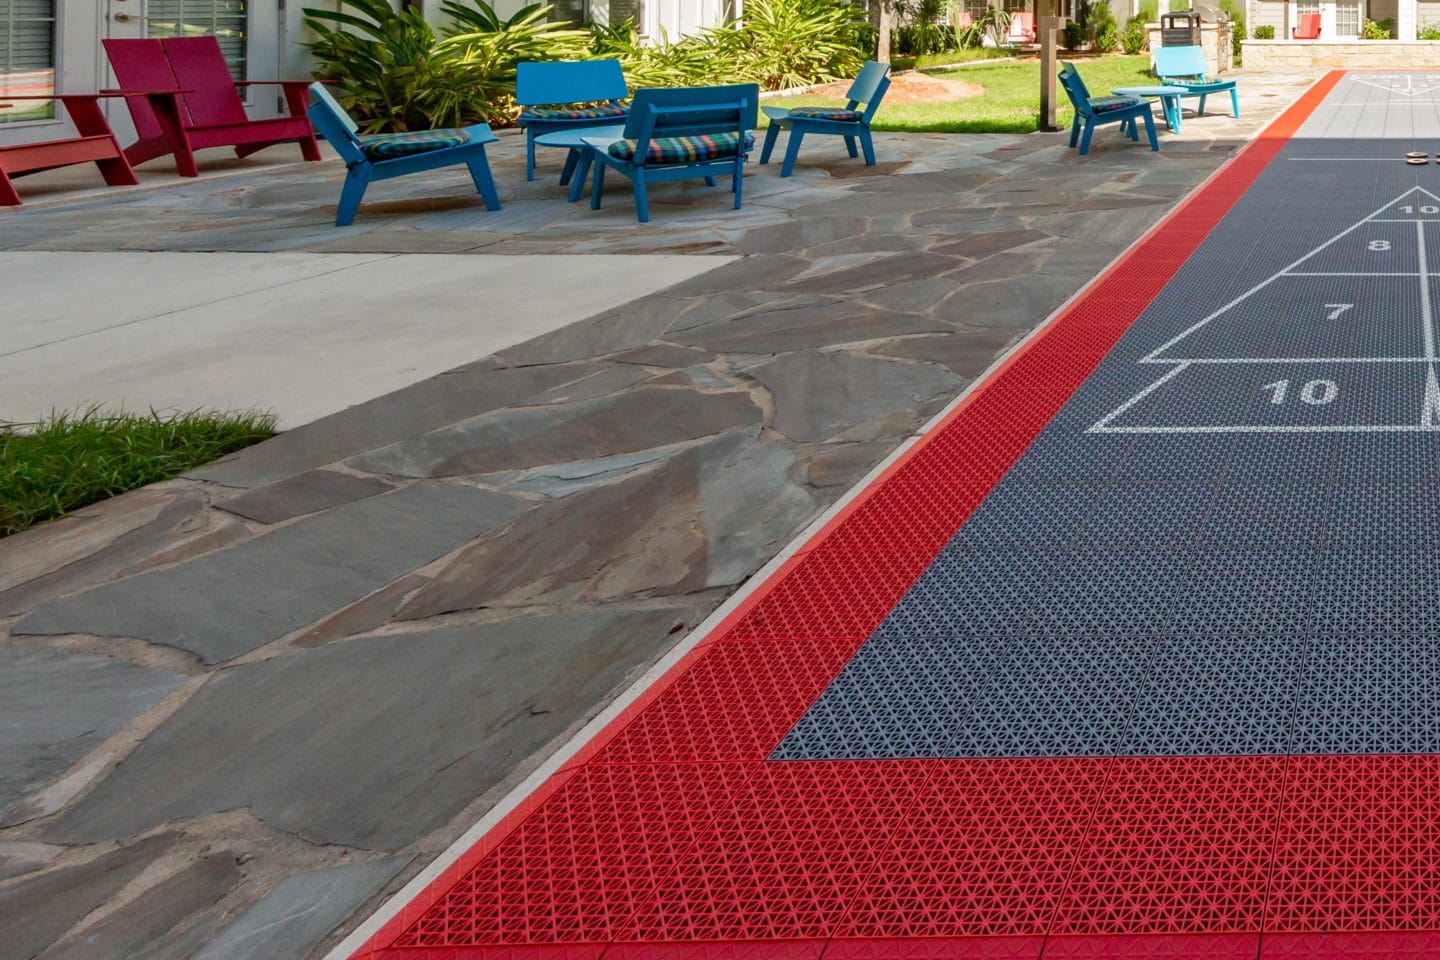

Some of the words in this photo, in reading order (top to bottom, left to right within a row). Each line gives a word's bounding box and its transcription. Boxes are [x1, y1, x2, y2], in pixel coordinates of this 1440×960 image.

[1398, 205, 1440, 214] 10
[1368, 240, 1392, 251] 8
[1324, 303, 1354, 320] 7
[1262, 378, 1339, 406] 10
